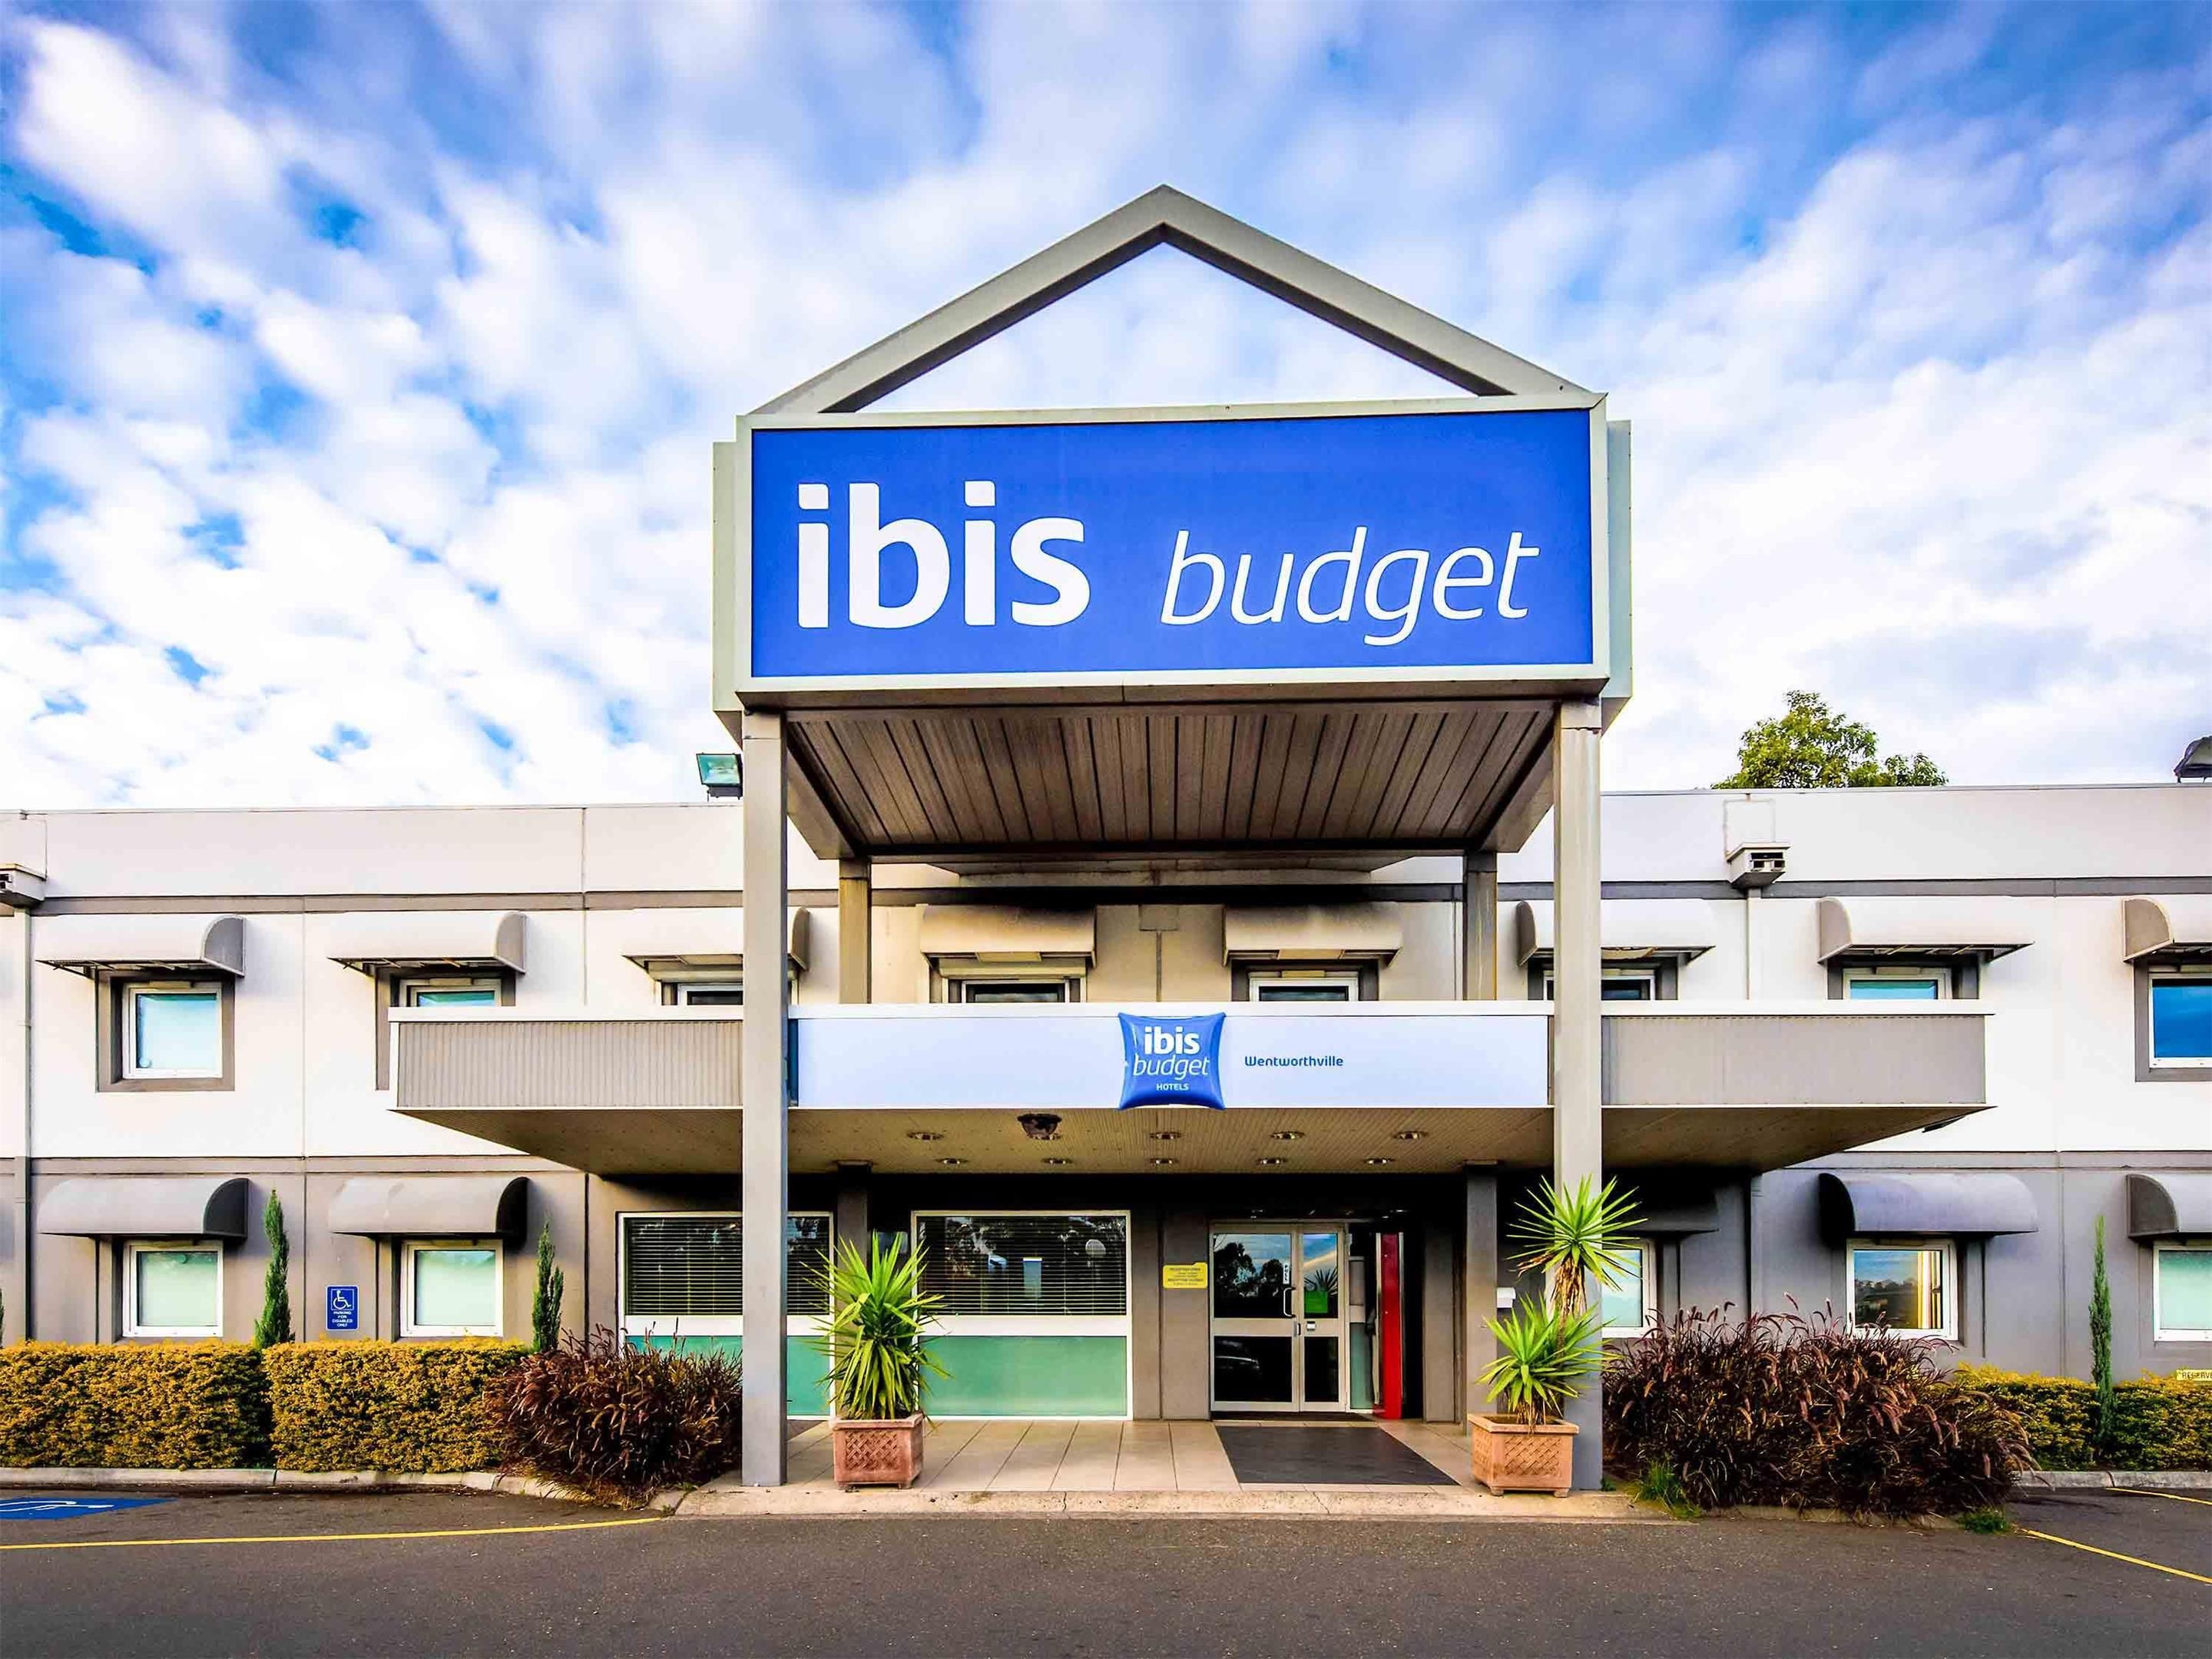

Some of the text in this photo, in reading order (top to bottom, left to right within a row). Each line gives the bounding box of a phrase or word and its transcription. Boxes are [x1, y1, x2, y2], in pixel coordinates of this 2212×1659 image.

[798, 481, 1540, 646] ibis budget
[1144, 1025, 1200, 1055] ibis
[1133, 1053, 1210, 1081] budget
[1244, 1055, 1344, 1067] Wentworthville
